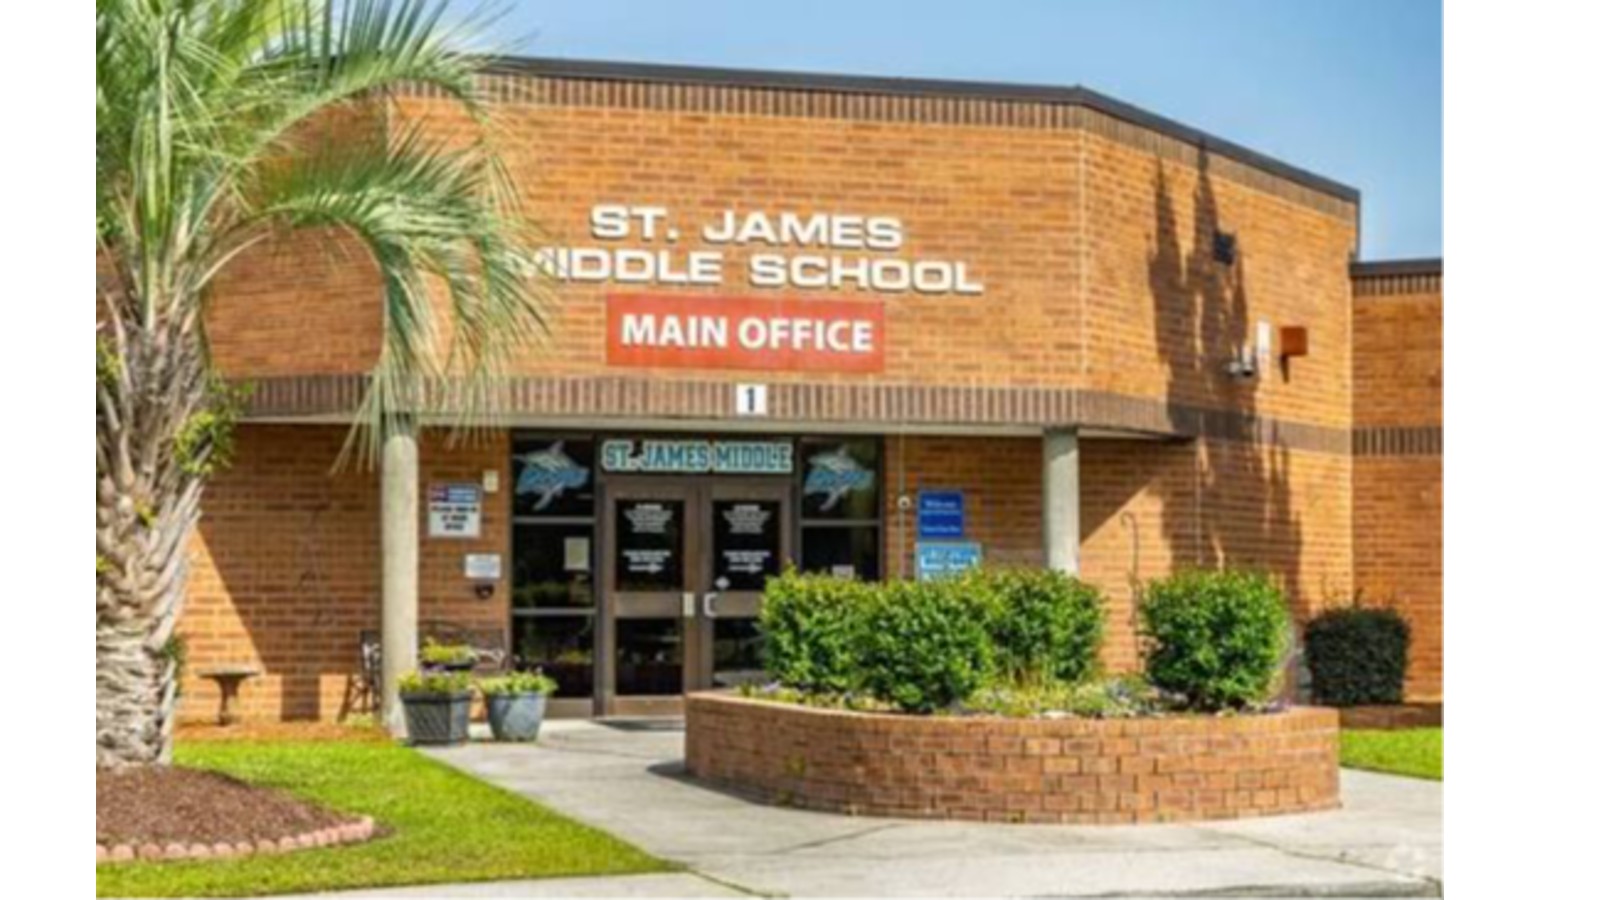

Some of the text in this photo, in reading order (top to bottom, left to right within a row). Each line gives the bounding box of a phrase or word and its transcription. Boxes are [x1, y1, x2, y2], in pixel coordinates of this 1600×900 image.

[590, 204, 904, 249] ST. JAMES
[749, 252, 984, 294] SCHOOL
[620, 313, 874, 352] MAIN OFFICE
[744, 387, 757, 412] 1
[602, 441, 792, 472] ST. JAMES MIDDLE
